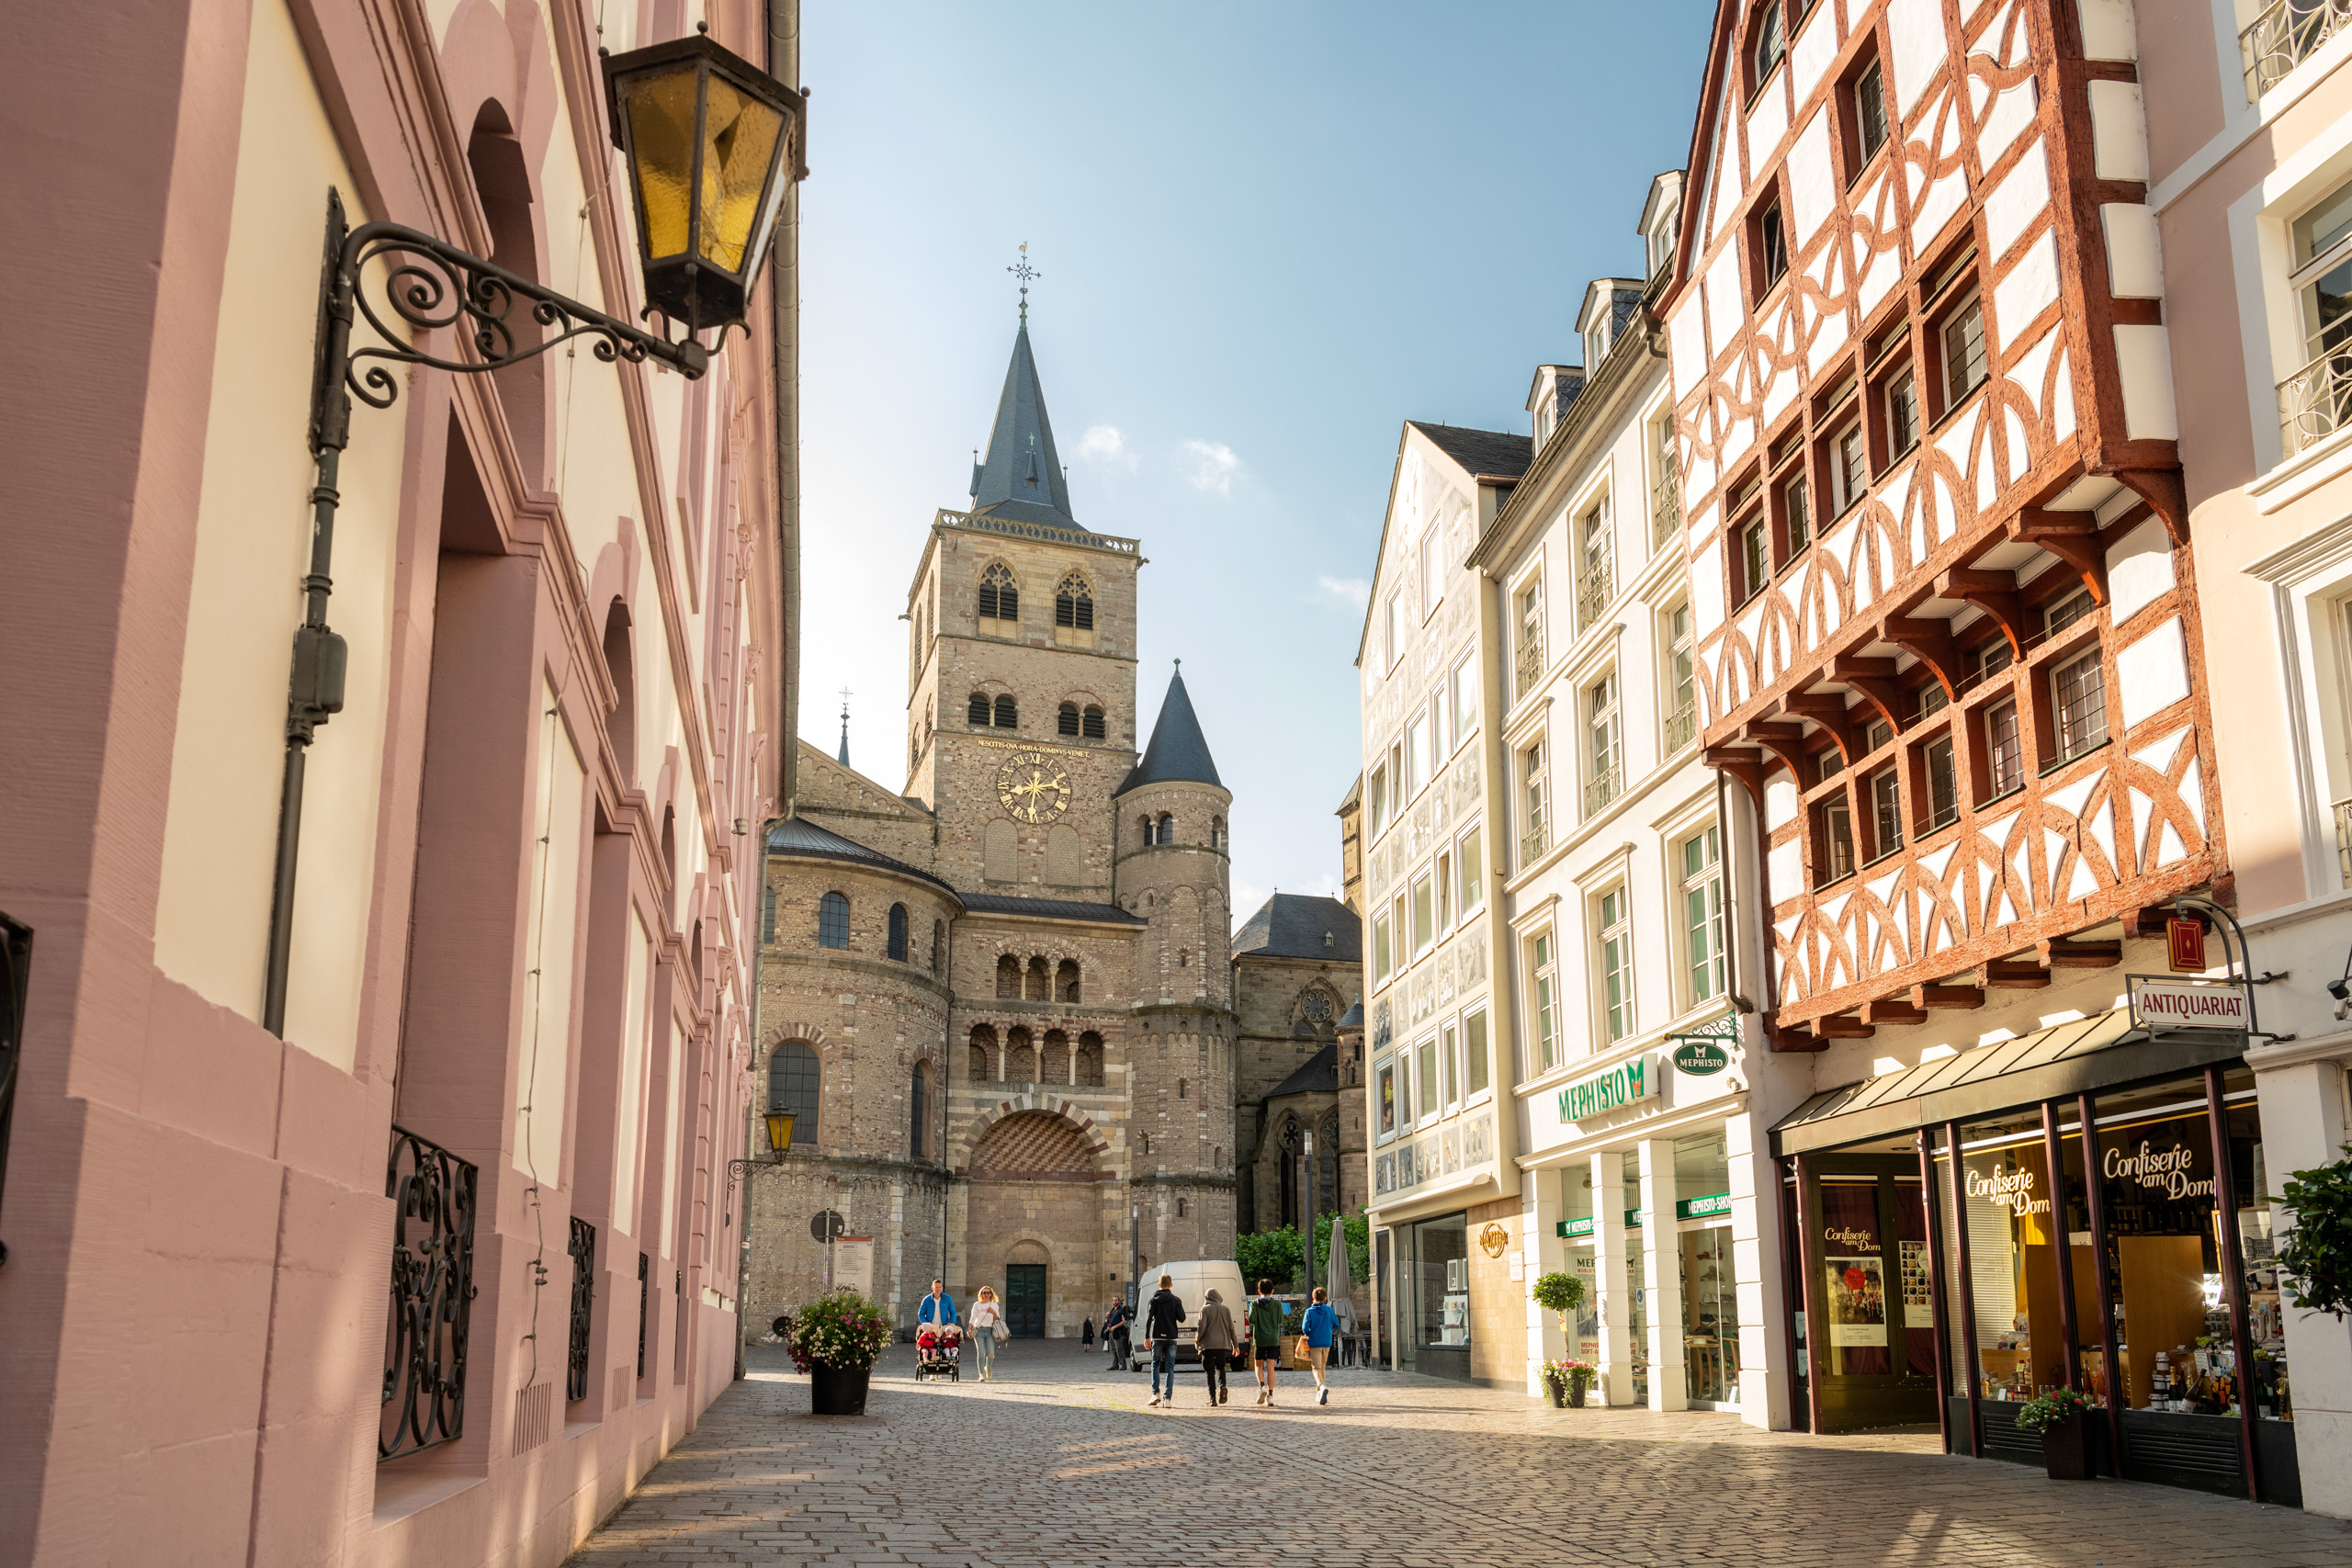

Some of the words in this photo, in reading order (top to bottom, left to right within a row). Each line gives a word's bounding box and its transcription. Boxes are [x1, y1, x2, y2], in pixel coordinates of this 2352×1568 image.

[2143, 993, 2242, 1019] ANTIQUARIAT
[1679, 1058, 1724, 1067] MEPHISTO
[1558, 1068, 1625, 1124] MEPHISTO
[2104, 1140, 2192, 1183] Confiserie
[1966, 1164, 2034, 1202] Confiserie
[2143, 1173, 2165, 1188] am
[2165, 1170, 2215, 1201] Dom
[1996, 1195, 2014, 1206] am
[2013, 1190, 2051, 1217] Dom
[1825, 1227, 1871, 1243] Confiserie
[1857, 1240, 1882, 1251] Dom
